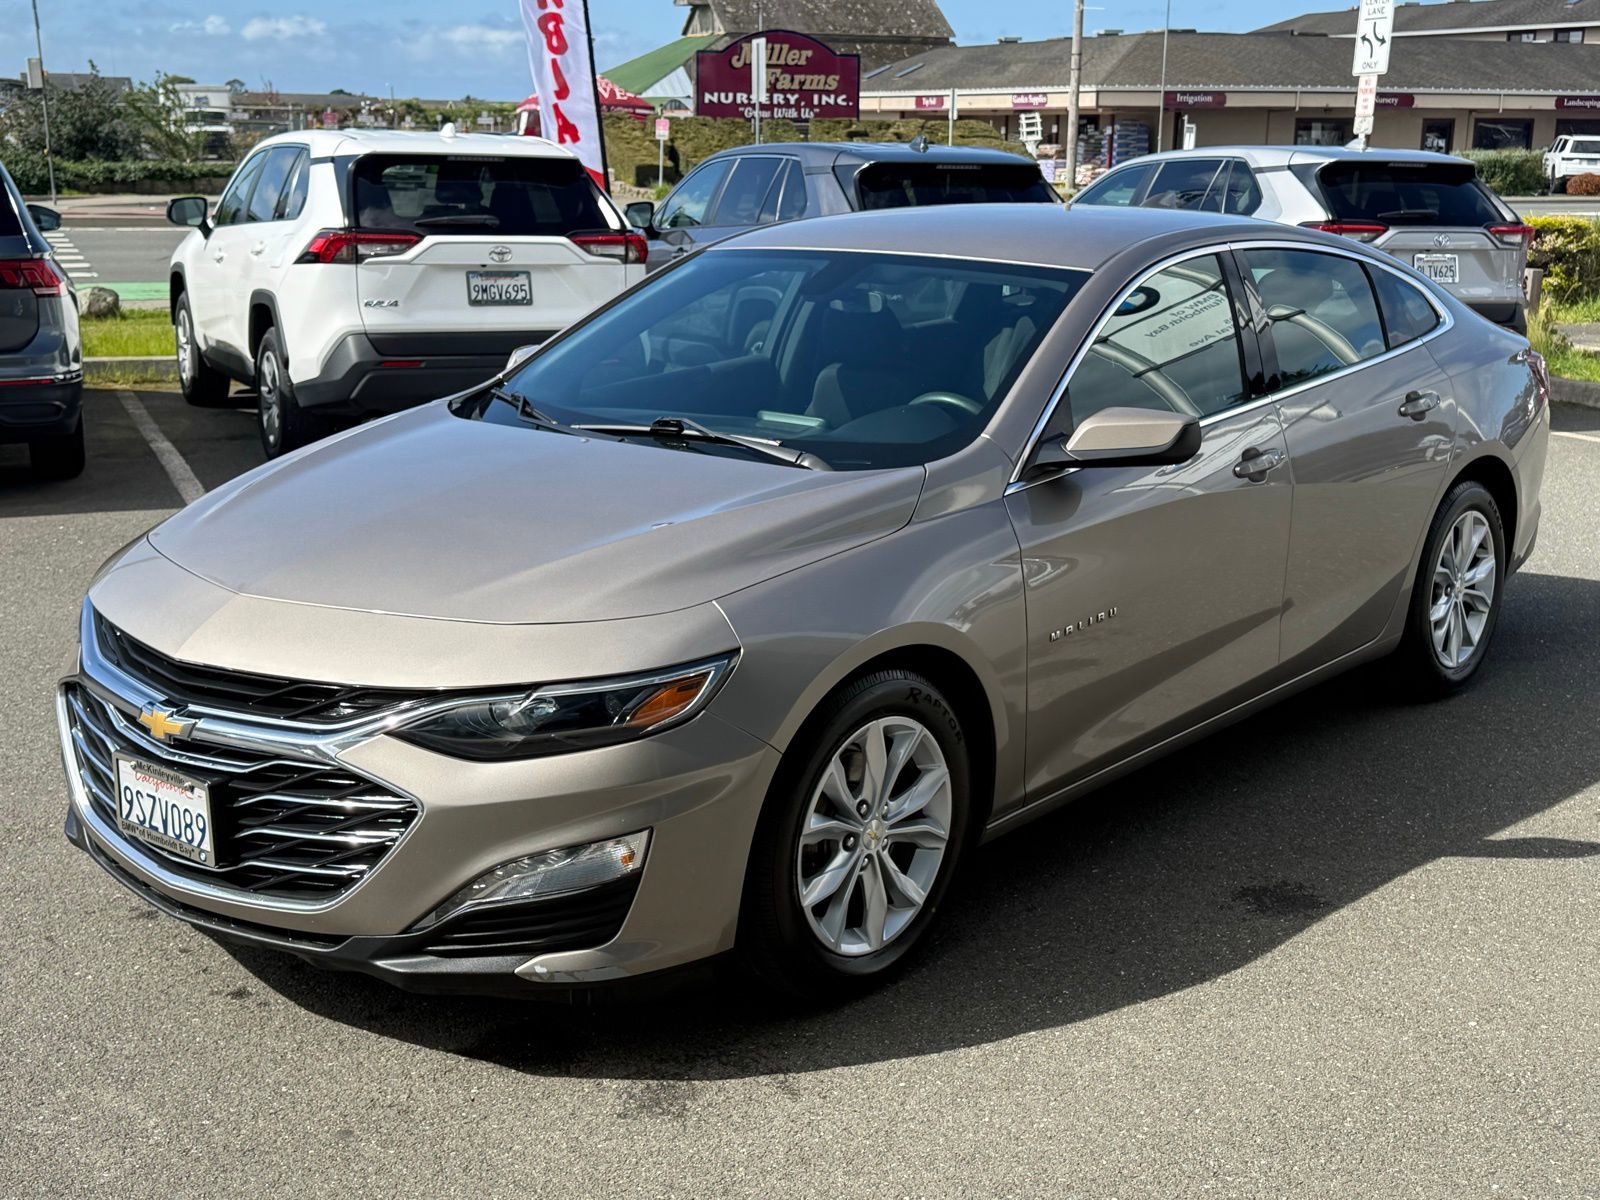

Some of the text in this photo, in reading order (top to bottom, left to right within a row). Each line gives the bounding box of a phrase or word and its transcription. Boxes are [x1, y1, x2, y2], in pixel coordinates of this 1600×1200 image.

[1367, 6, 1386, 16] LANE
[1361, 60, 1378, 70] ONLY
[765, 68, 840, 90] Farms
[813, 93, 854, 106] INC.
[1176, 93, 1213, 105] Irrigation
[472, 283, 528, 300] 9MGV695
[1049, 607, 1118, 643] MALIBU
[123, 785, 207, 849] 9SZV089
